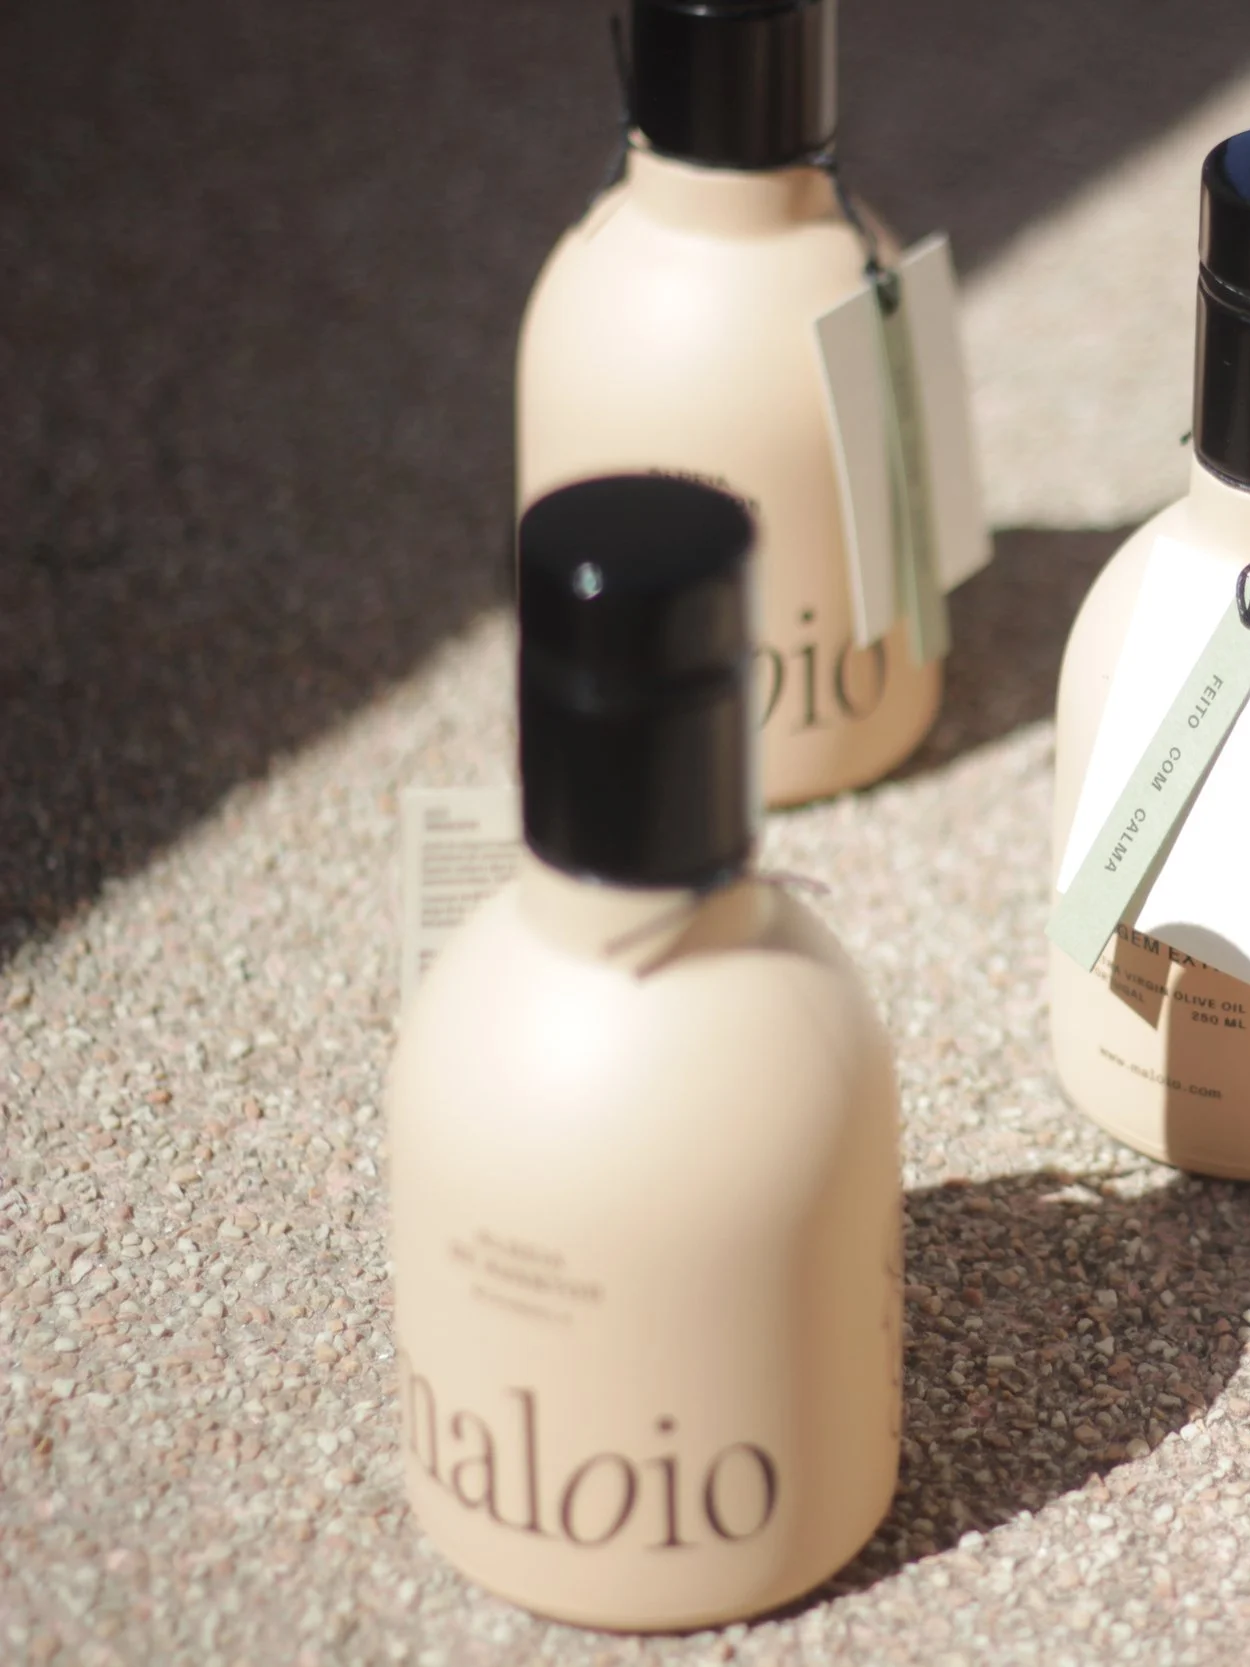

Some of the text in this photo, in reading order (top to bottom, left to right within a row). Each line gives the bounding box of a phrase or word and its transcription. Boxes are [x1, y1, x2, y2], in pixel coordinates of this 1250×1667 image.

[1104, 675, 1224, 872] FEITO COM CALMA
[1126, 969, 1168, 996] VIRGIN
[1174, 990, 1216, 1010] OLIVE
[1221, 1000, 1246, 1015] OIL
[1192, 1010, 1246, 1029] 250 ML
[1099, 1045, 1222, 1100] www.maloio.com
